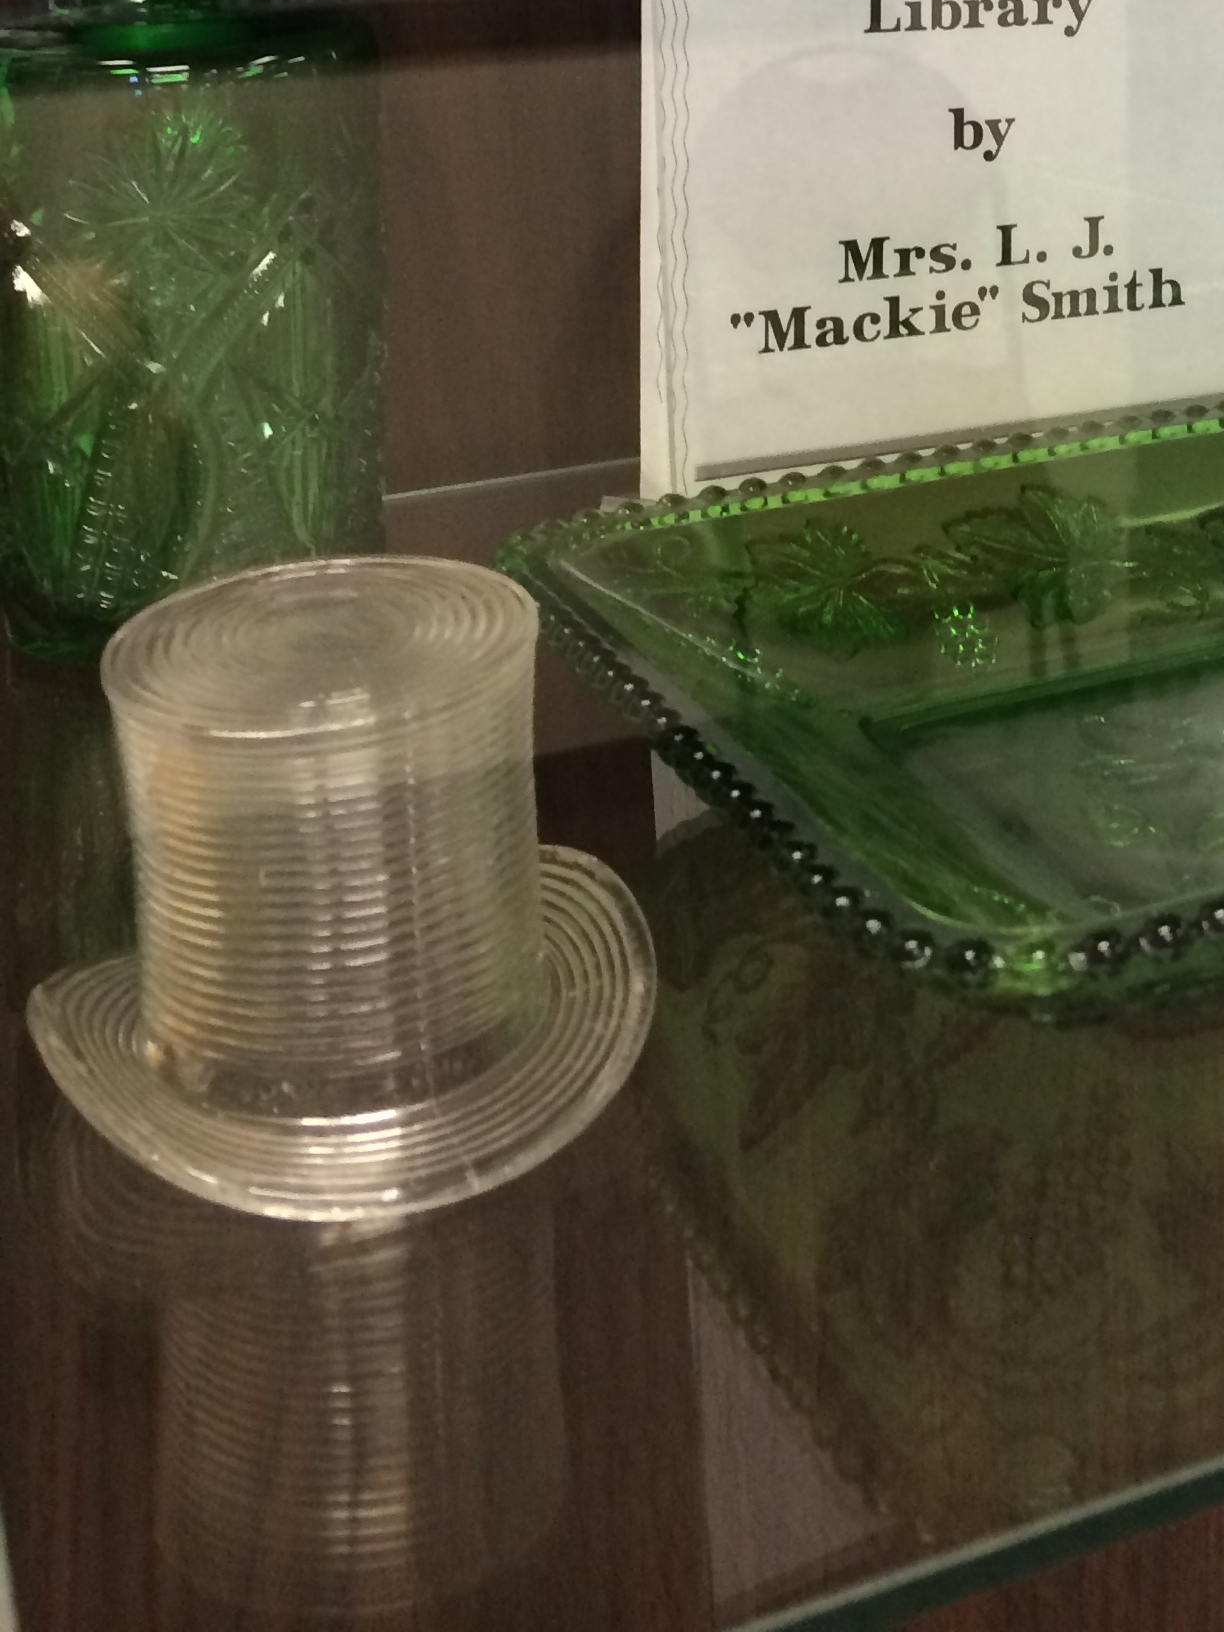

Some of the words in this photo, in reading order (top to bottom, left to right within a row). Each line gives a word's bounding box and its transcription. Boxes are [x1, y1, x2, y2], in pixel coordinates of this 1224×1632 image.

[948, 107, 1016, 163] by
[839, 235, 972, 284] Mrs.
[996, 223, 1048, 267] L.
[1073, 215, 1114, 259] J.
[731, 285, 999, 355] "Mackie"
[1022, 267, 1186, 324] Smith
